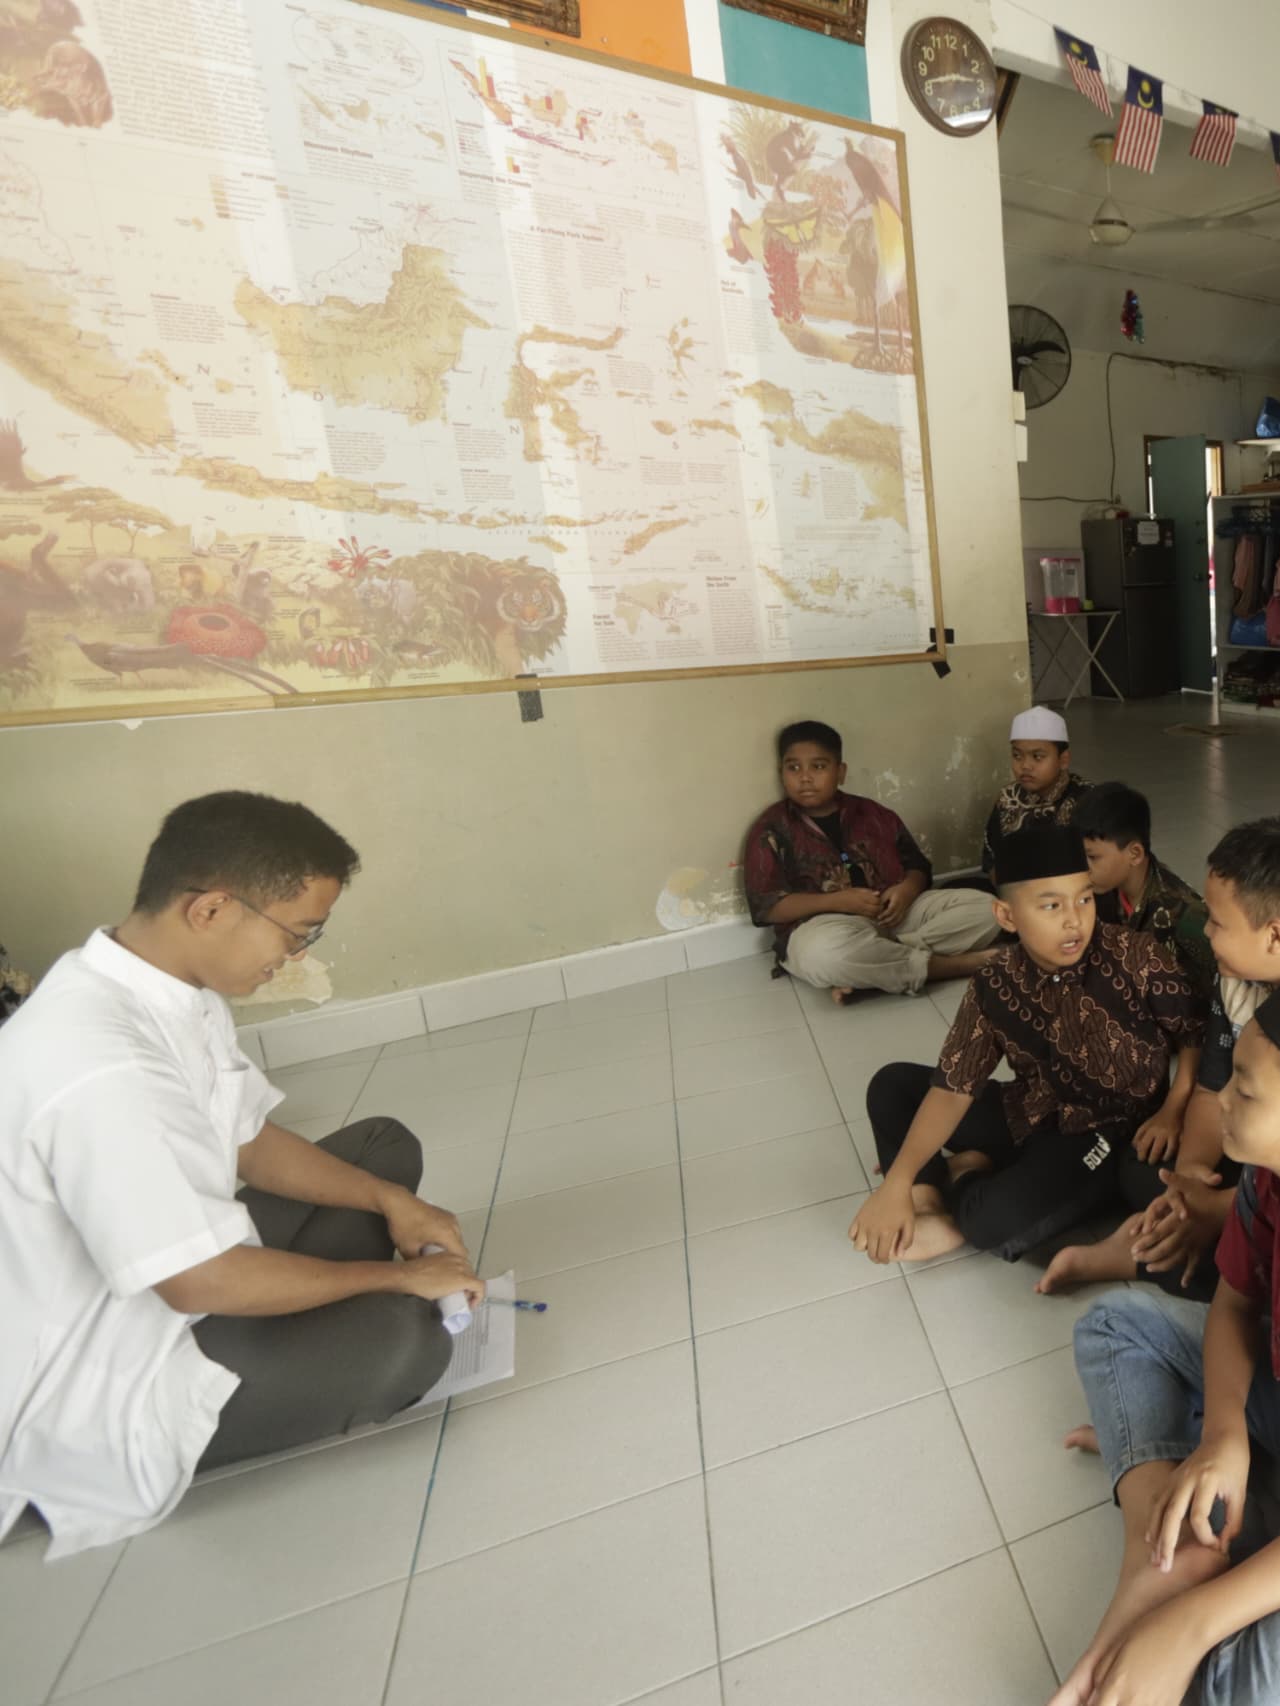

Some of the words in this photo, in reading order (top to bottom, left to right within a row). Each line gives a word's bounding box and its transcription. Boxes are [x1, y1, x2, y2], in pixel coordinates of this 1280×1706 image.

[930, 34, 941, 49] 11
[944, 33, 957, 50] 12
[922, 46, 935, 62] 10
[963, 44, 968, 57] 1
[918, 62, 928, 76] 9
[971, 60, 980, 73] 2
[924, 81, 933, 96] 8
[977, 80, 985, 93] 3
[937, 98, 946, 112] 7
[972, 96, 981, 109] 4
